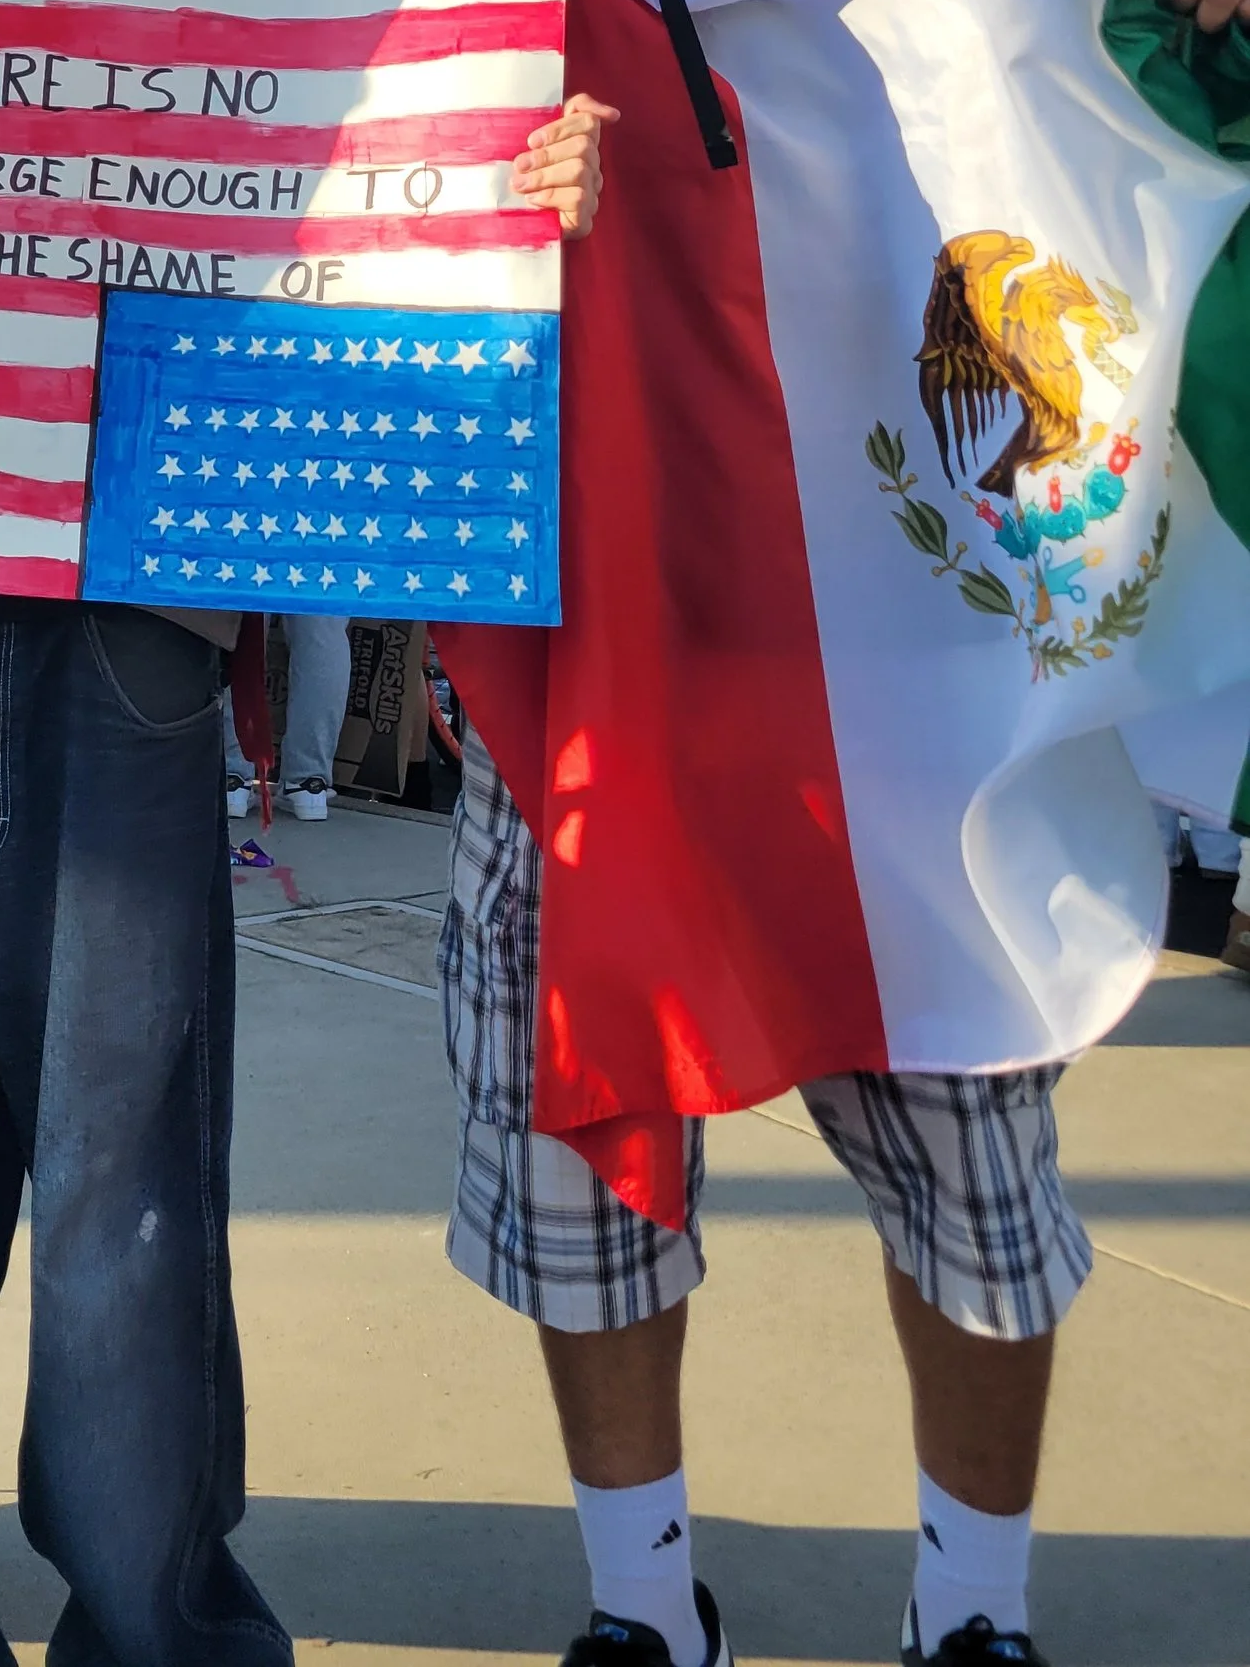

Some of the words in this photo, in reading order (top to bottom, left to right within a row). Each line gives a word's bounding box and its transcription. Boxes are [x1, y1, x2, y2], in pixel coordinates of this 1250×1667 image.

[93, 62, 177, 114] IS
[201, 67, 279, 117] NO
[88, 157, 303, 211] ENOUGH
[346, 166, 443, 211] TO
[66, 238, 236, 296] SHAME
[280, 260, 345, 302] OF
[354, 638, 374, 709] TRIFOLD
